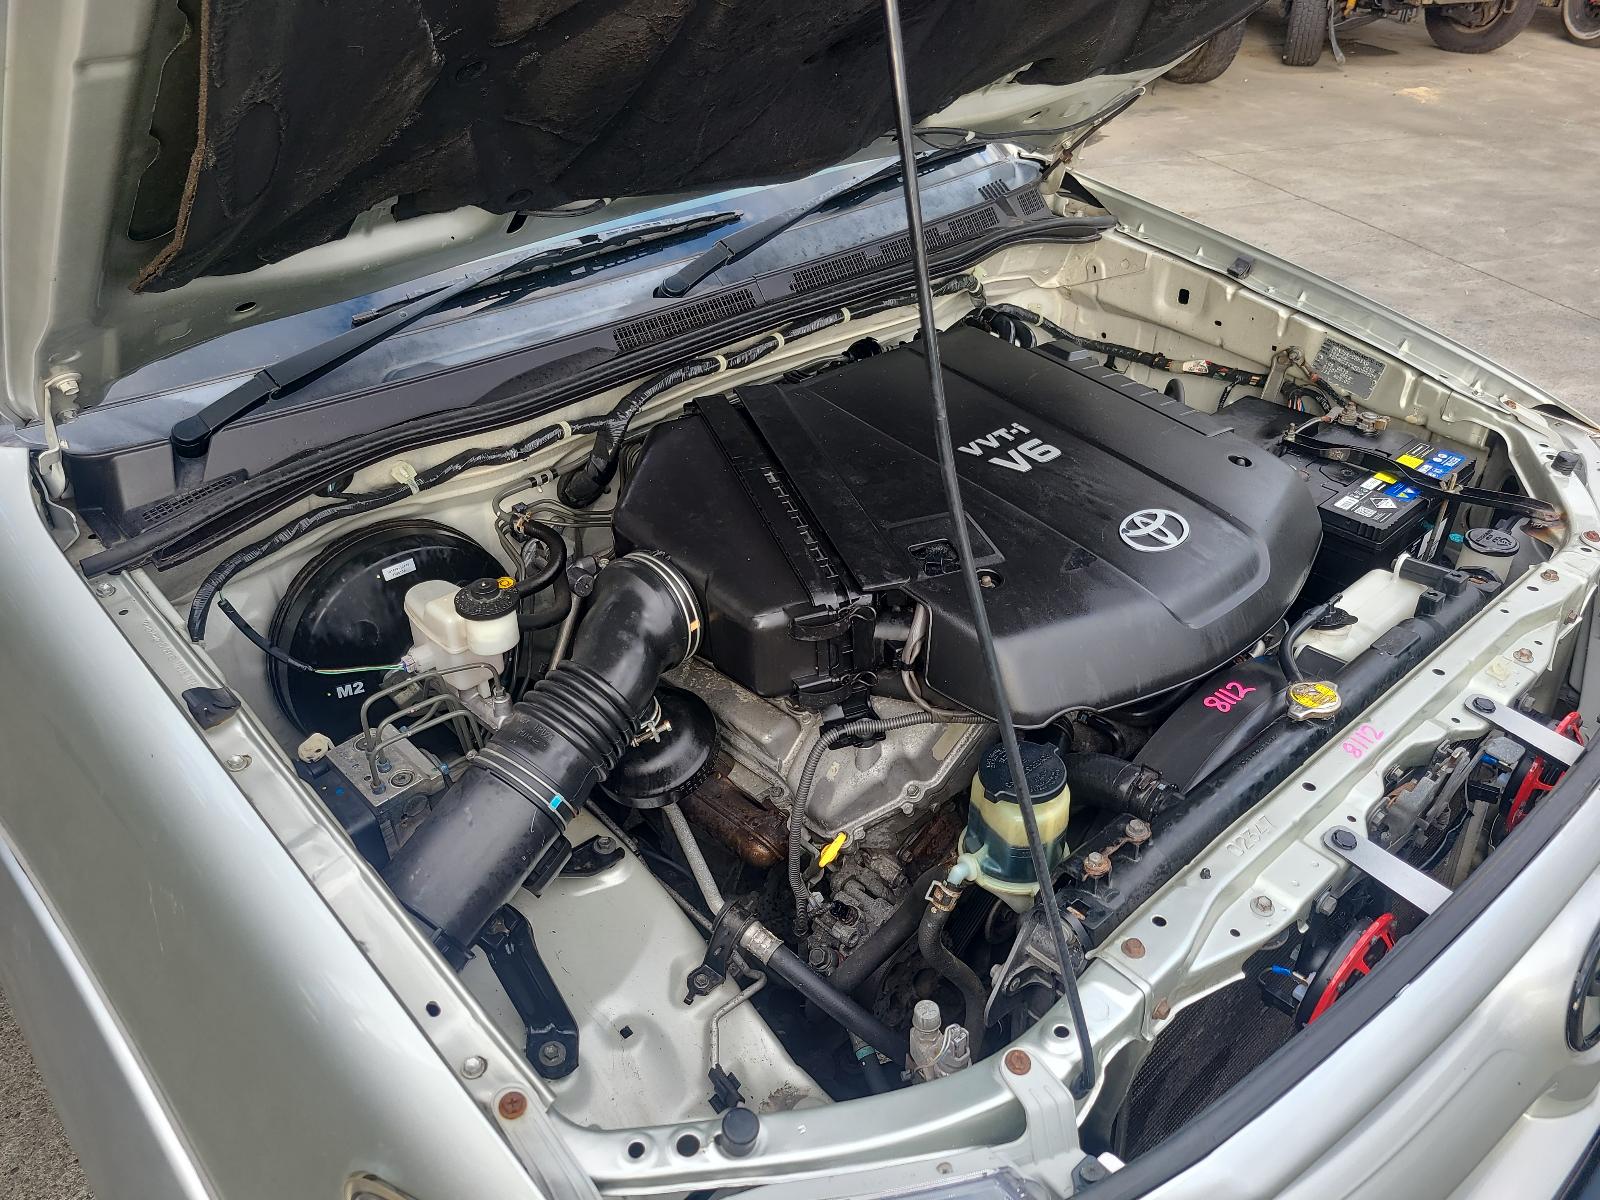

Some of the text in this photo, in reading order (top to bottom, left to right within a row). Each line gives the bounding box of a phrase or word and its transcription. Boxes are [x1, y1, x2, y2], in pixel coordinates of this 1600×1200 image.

[957, 422, 1032, 456] VVT-i
[988, 438, 1062, 473] V6
[336, 681, 365, 699] M2
[1203, 681, 1256, 713] 8112
[1342, 722, 1385, 759] 8112
